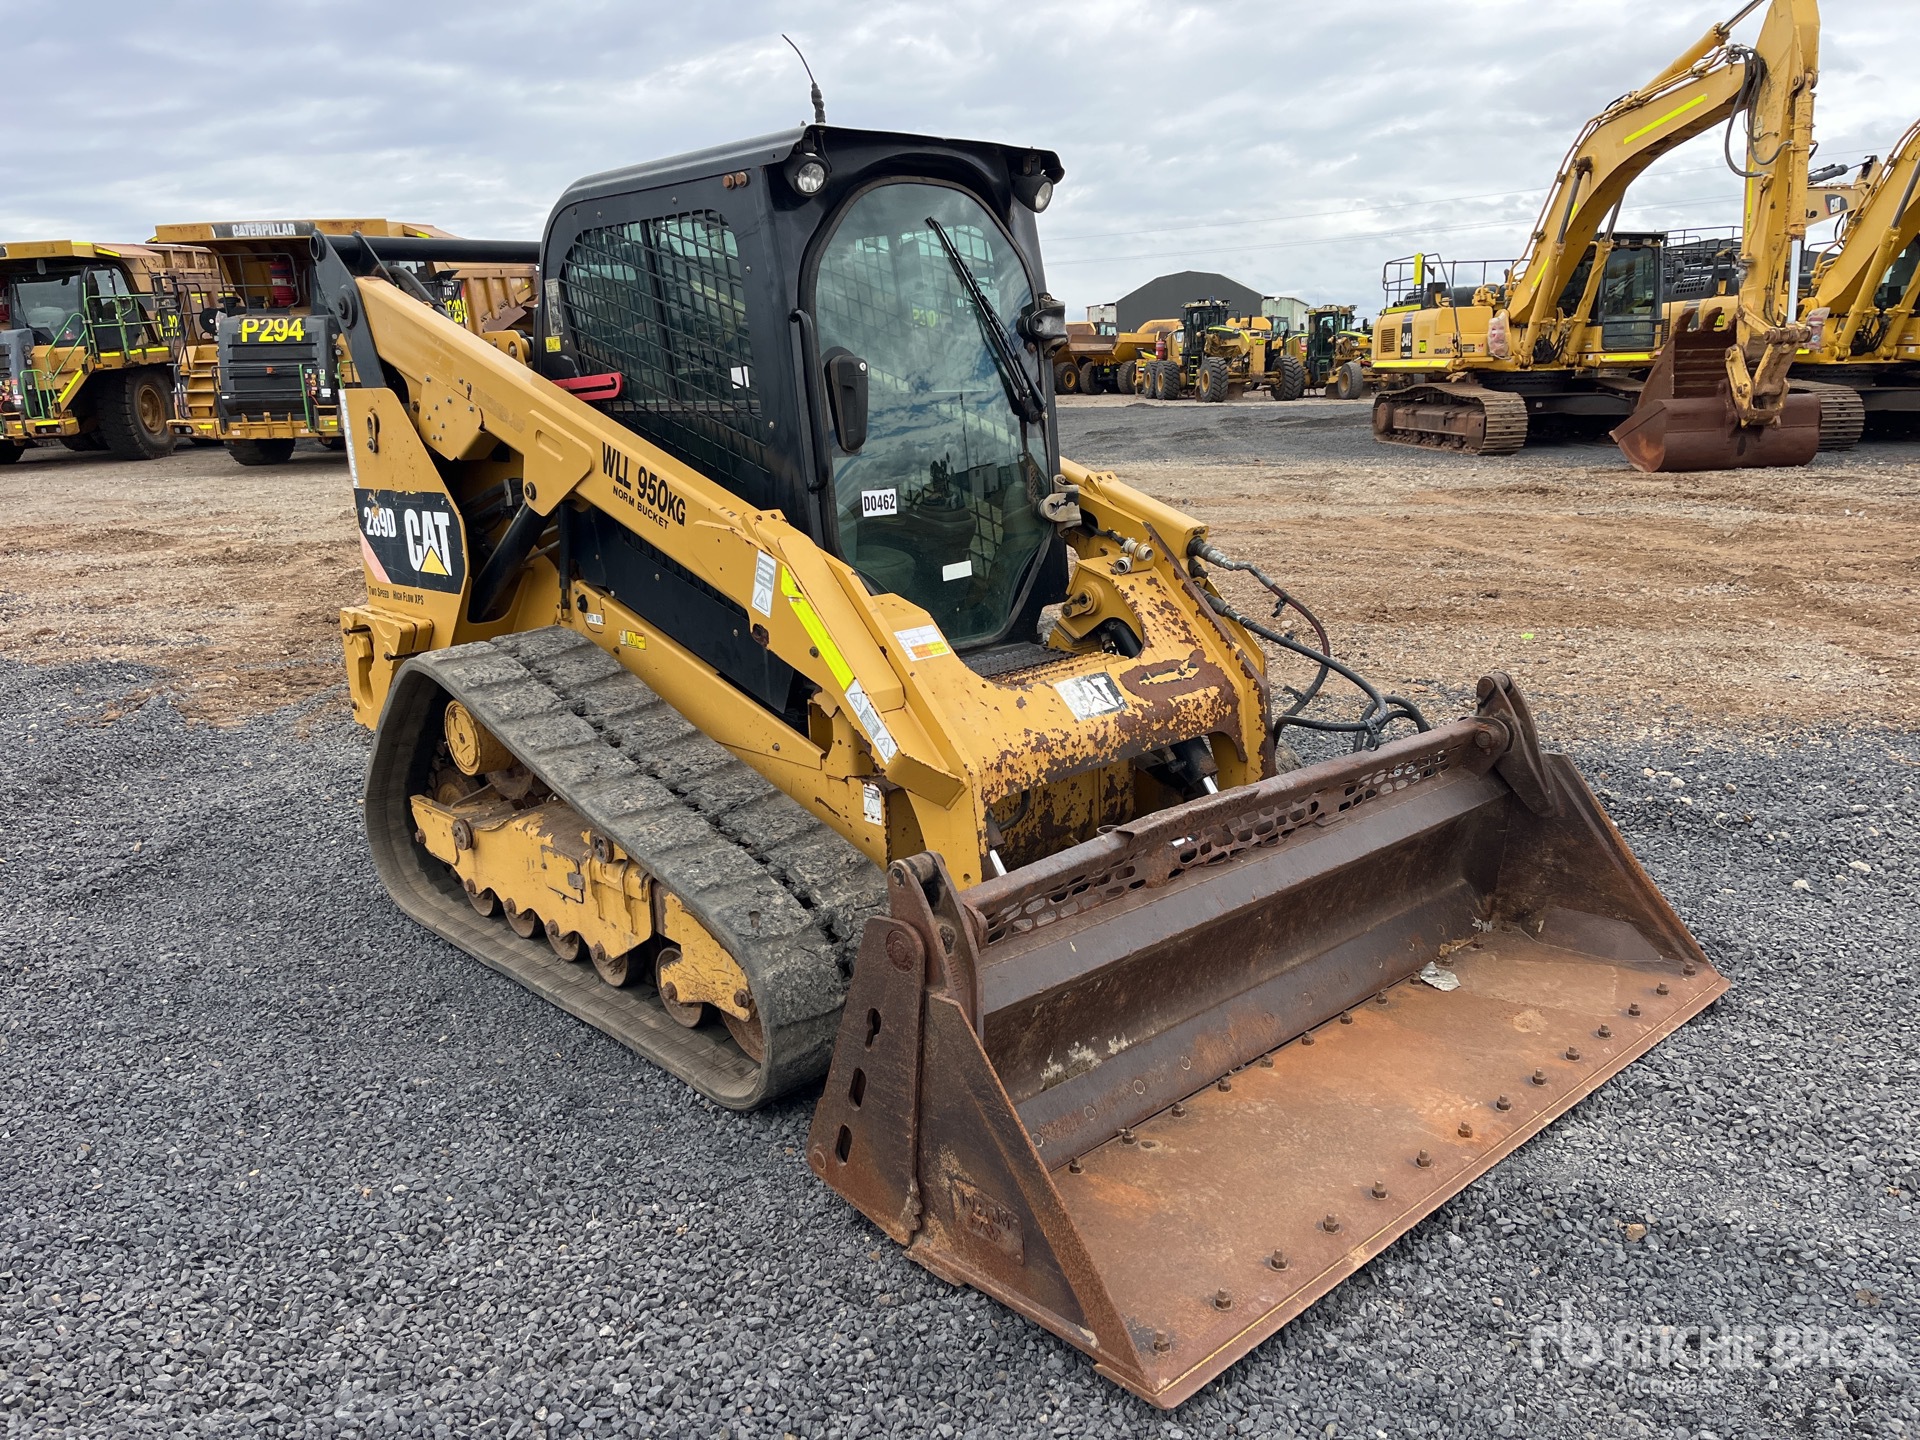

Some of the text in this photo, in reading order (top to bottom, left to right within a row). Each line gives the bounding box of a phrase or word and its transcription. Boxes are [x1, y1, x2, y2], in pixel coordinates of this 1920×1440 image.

[231, 223, 297, 237] CATERPILLAR
[241, 317, 305, 343] P294
[602, 441, 686, 527] WLL 950KG
[612, 485, 670, 530] NORM BUCKET
[863, 493, 896, 512] D0462
[363, 506, 453, 577] 289D CAT
[414, 594, 425, 605] XPS
